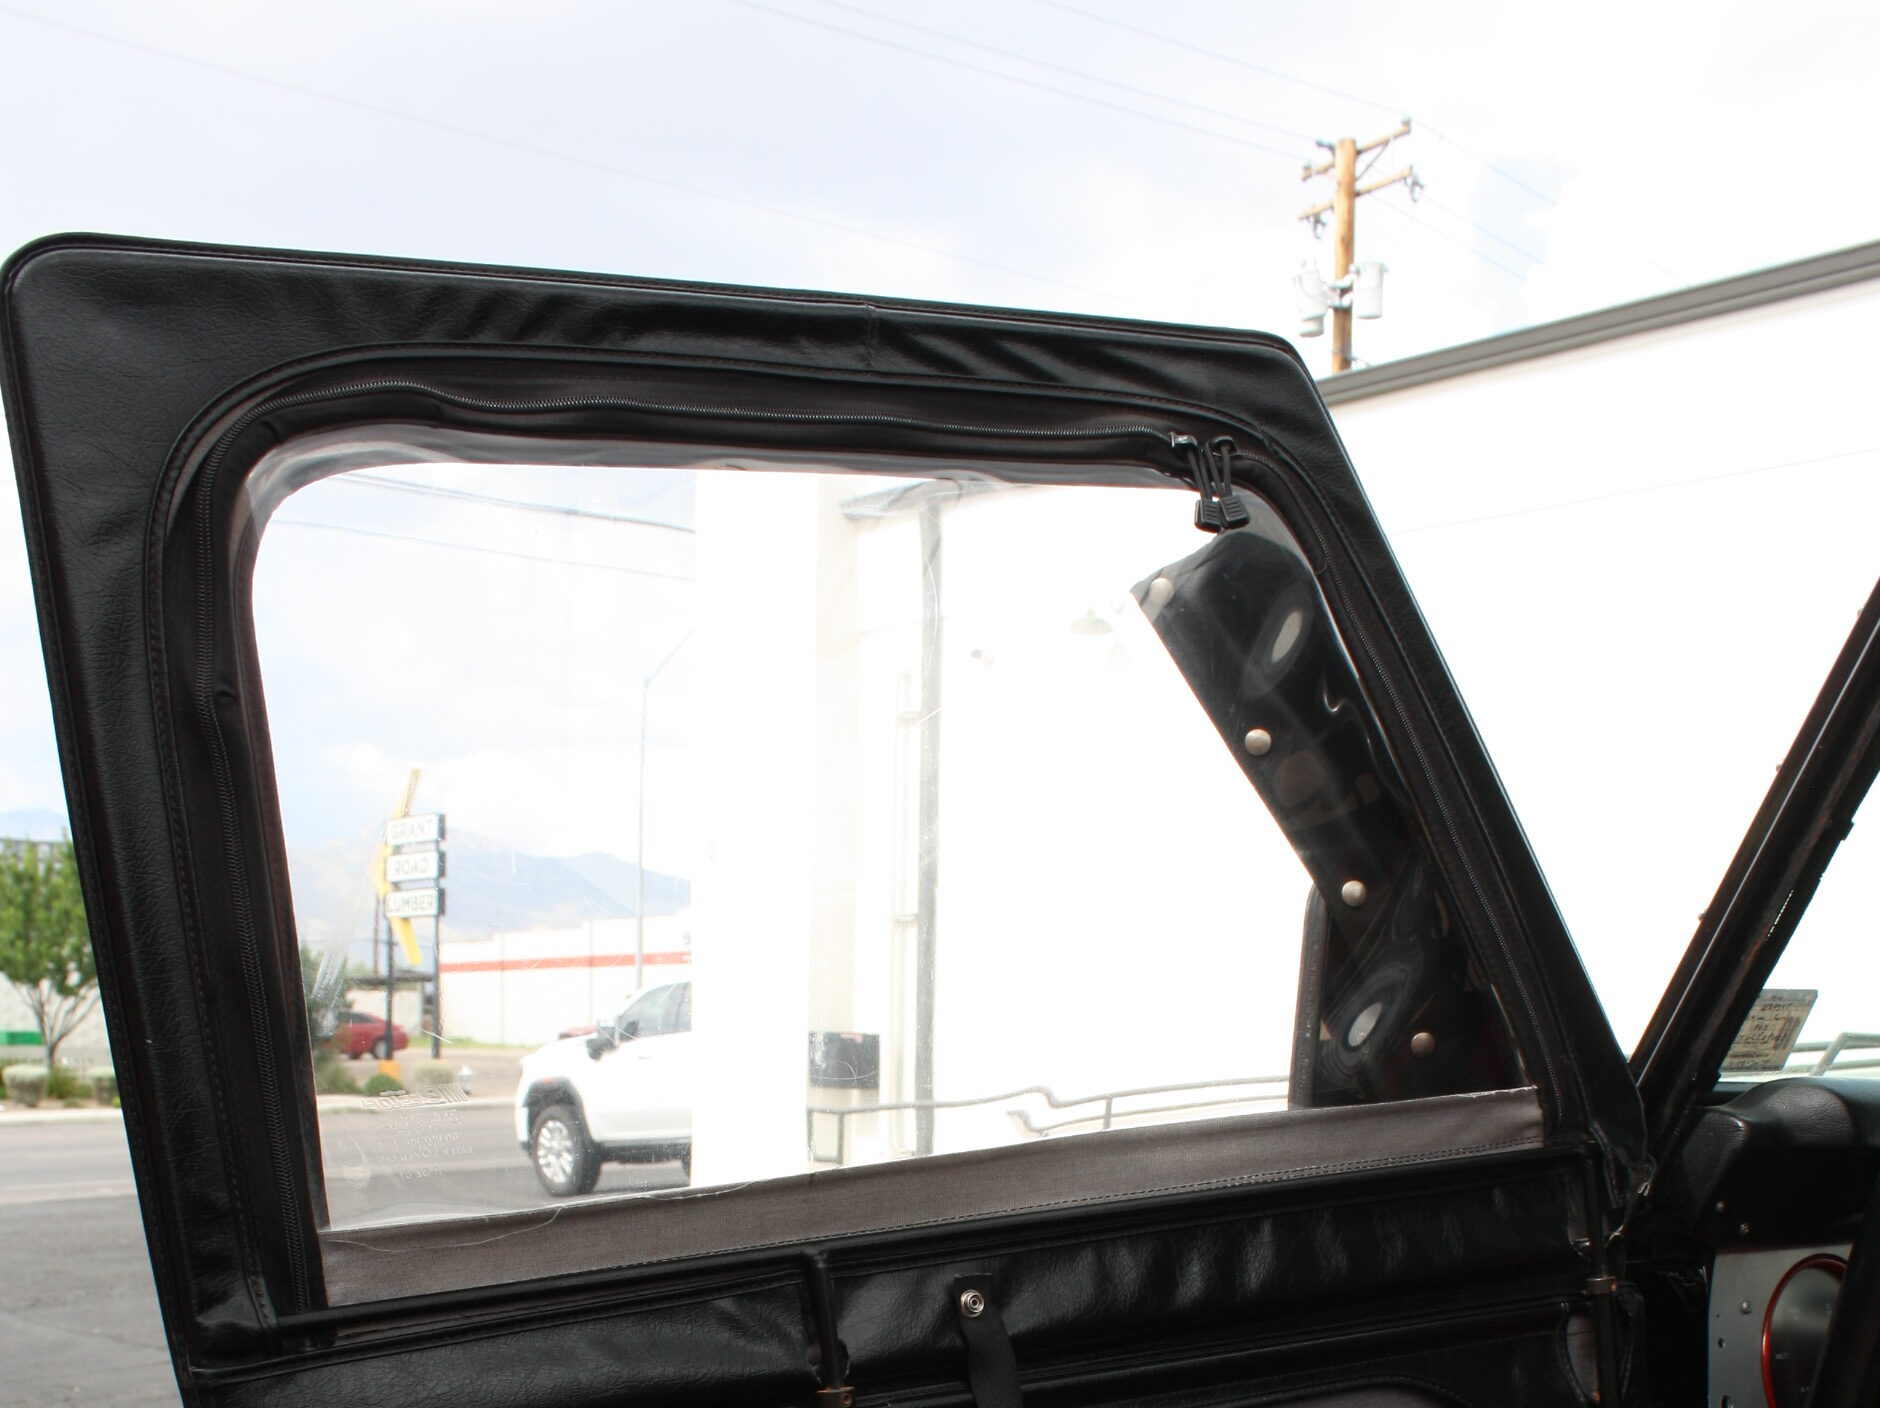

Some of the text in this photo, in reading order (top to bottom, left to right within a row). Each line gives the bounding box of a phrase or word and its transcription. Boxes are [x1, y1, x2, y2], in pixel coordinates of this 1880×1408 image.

[390, 820, 433, 841] GRANT
[393, 857, 429, 875] ROAD
[387, 894, 434, 912] LUMBER
